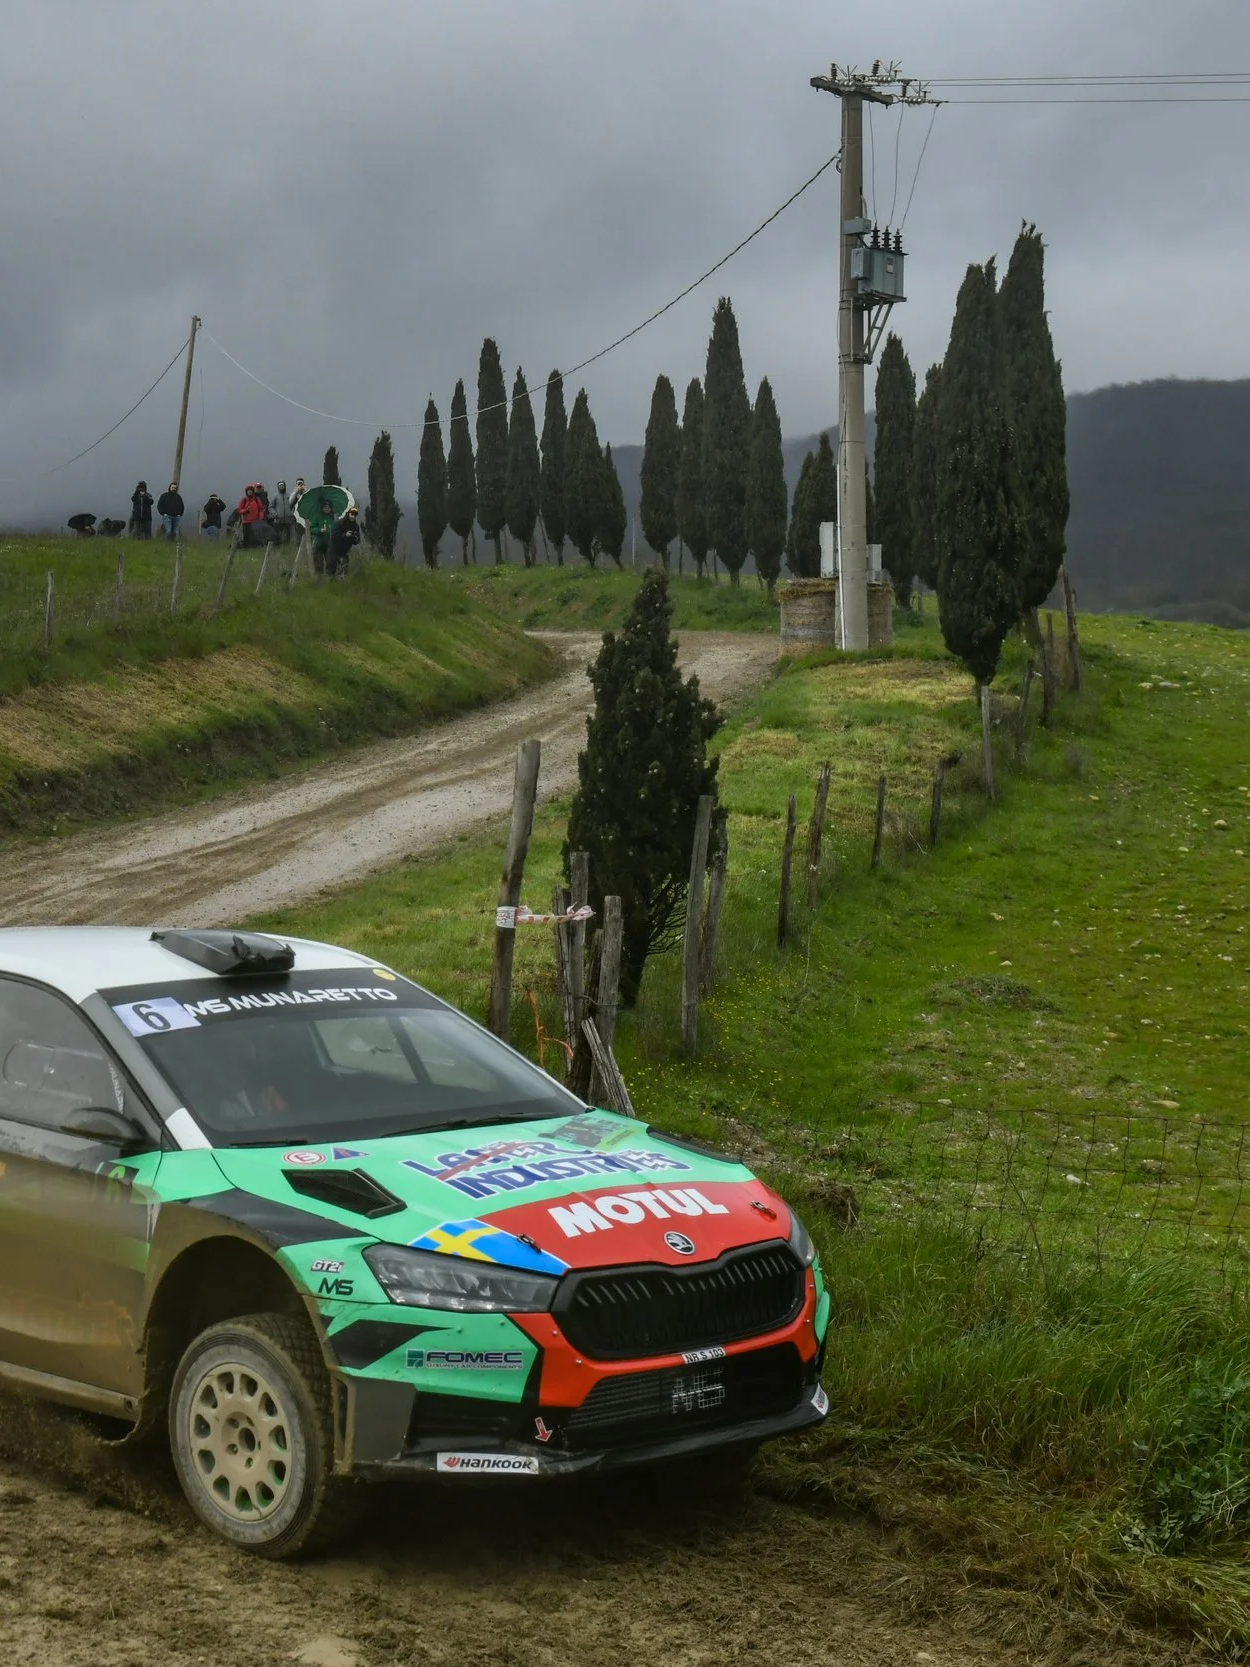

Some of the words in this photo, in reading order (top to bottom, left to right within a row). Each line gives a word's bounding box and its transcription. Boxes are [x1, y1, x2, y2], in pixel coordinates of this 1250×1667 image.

[132, 1003, 171, 1031] 6
[183, 998, 232, 1017] MS
[228, 988, 398, 1011] MUNARETTO
[400, 1141, 590, 1177] LASER
[447, 1150, 693, 1199] INDUSTRIES
[547, 1188, 730, 1238] MOTUL
[318, 1277, 354, 1295] MS
[426, 1351, 523, 1364] FOMEC
